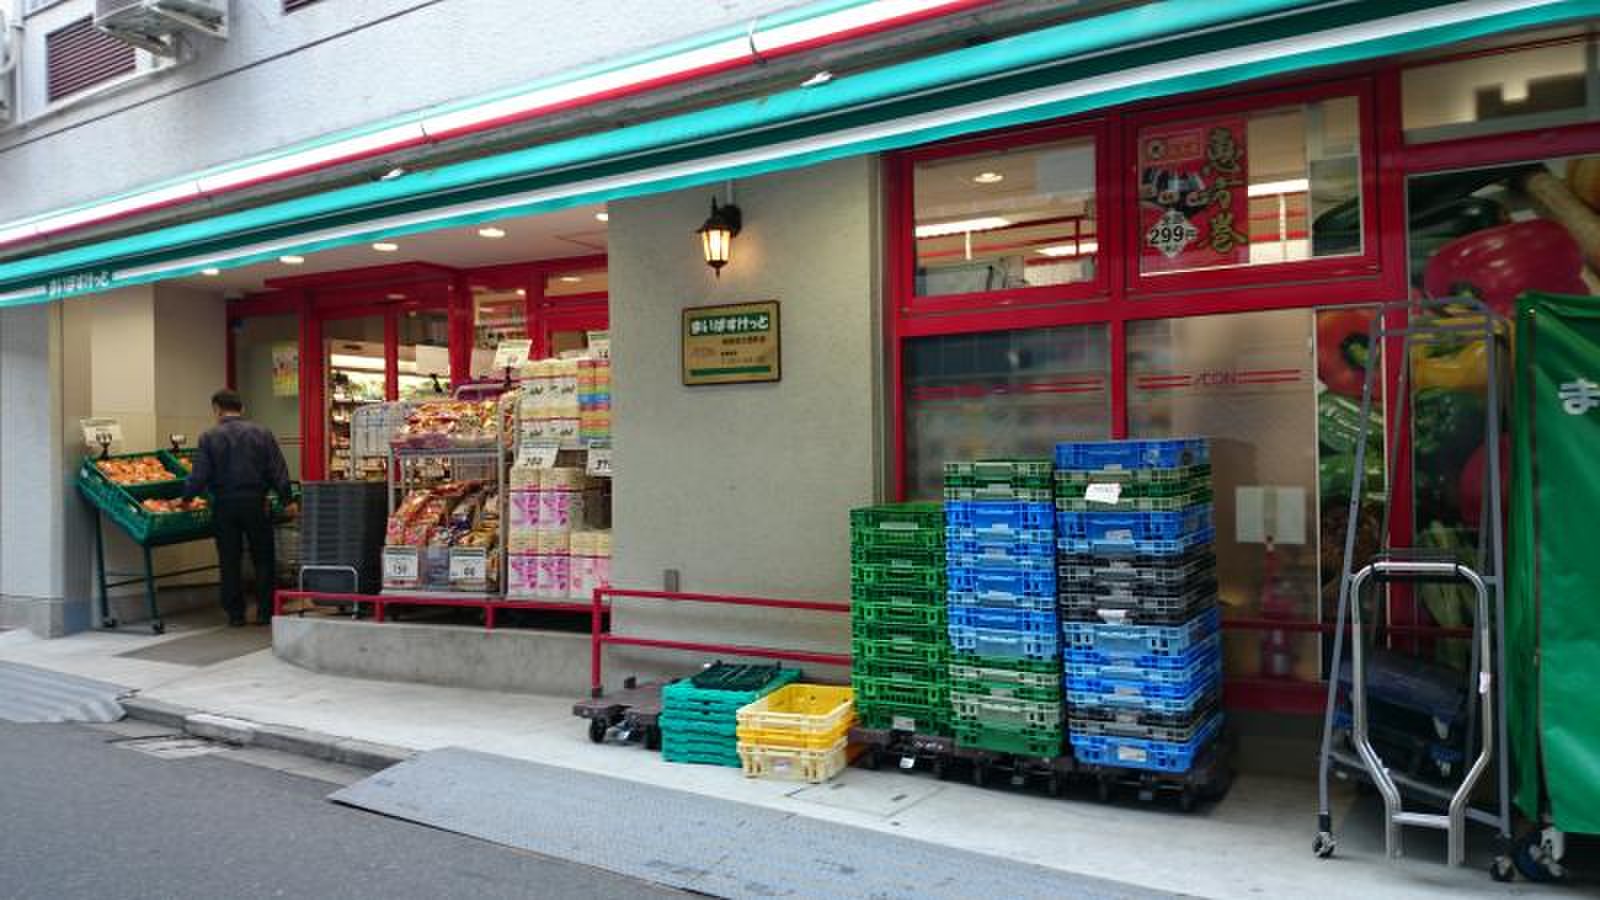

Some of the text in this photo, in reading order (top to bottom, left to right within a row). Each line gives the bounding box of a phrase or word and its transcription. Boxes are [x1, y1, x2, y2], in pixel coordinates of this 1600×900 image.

[691, 315, 769, 335] まいばすけっと
[1558, 377, 1600, 416] ま
